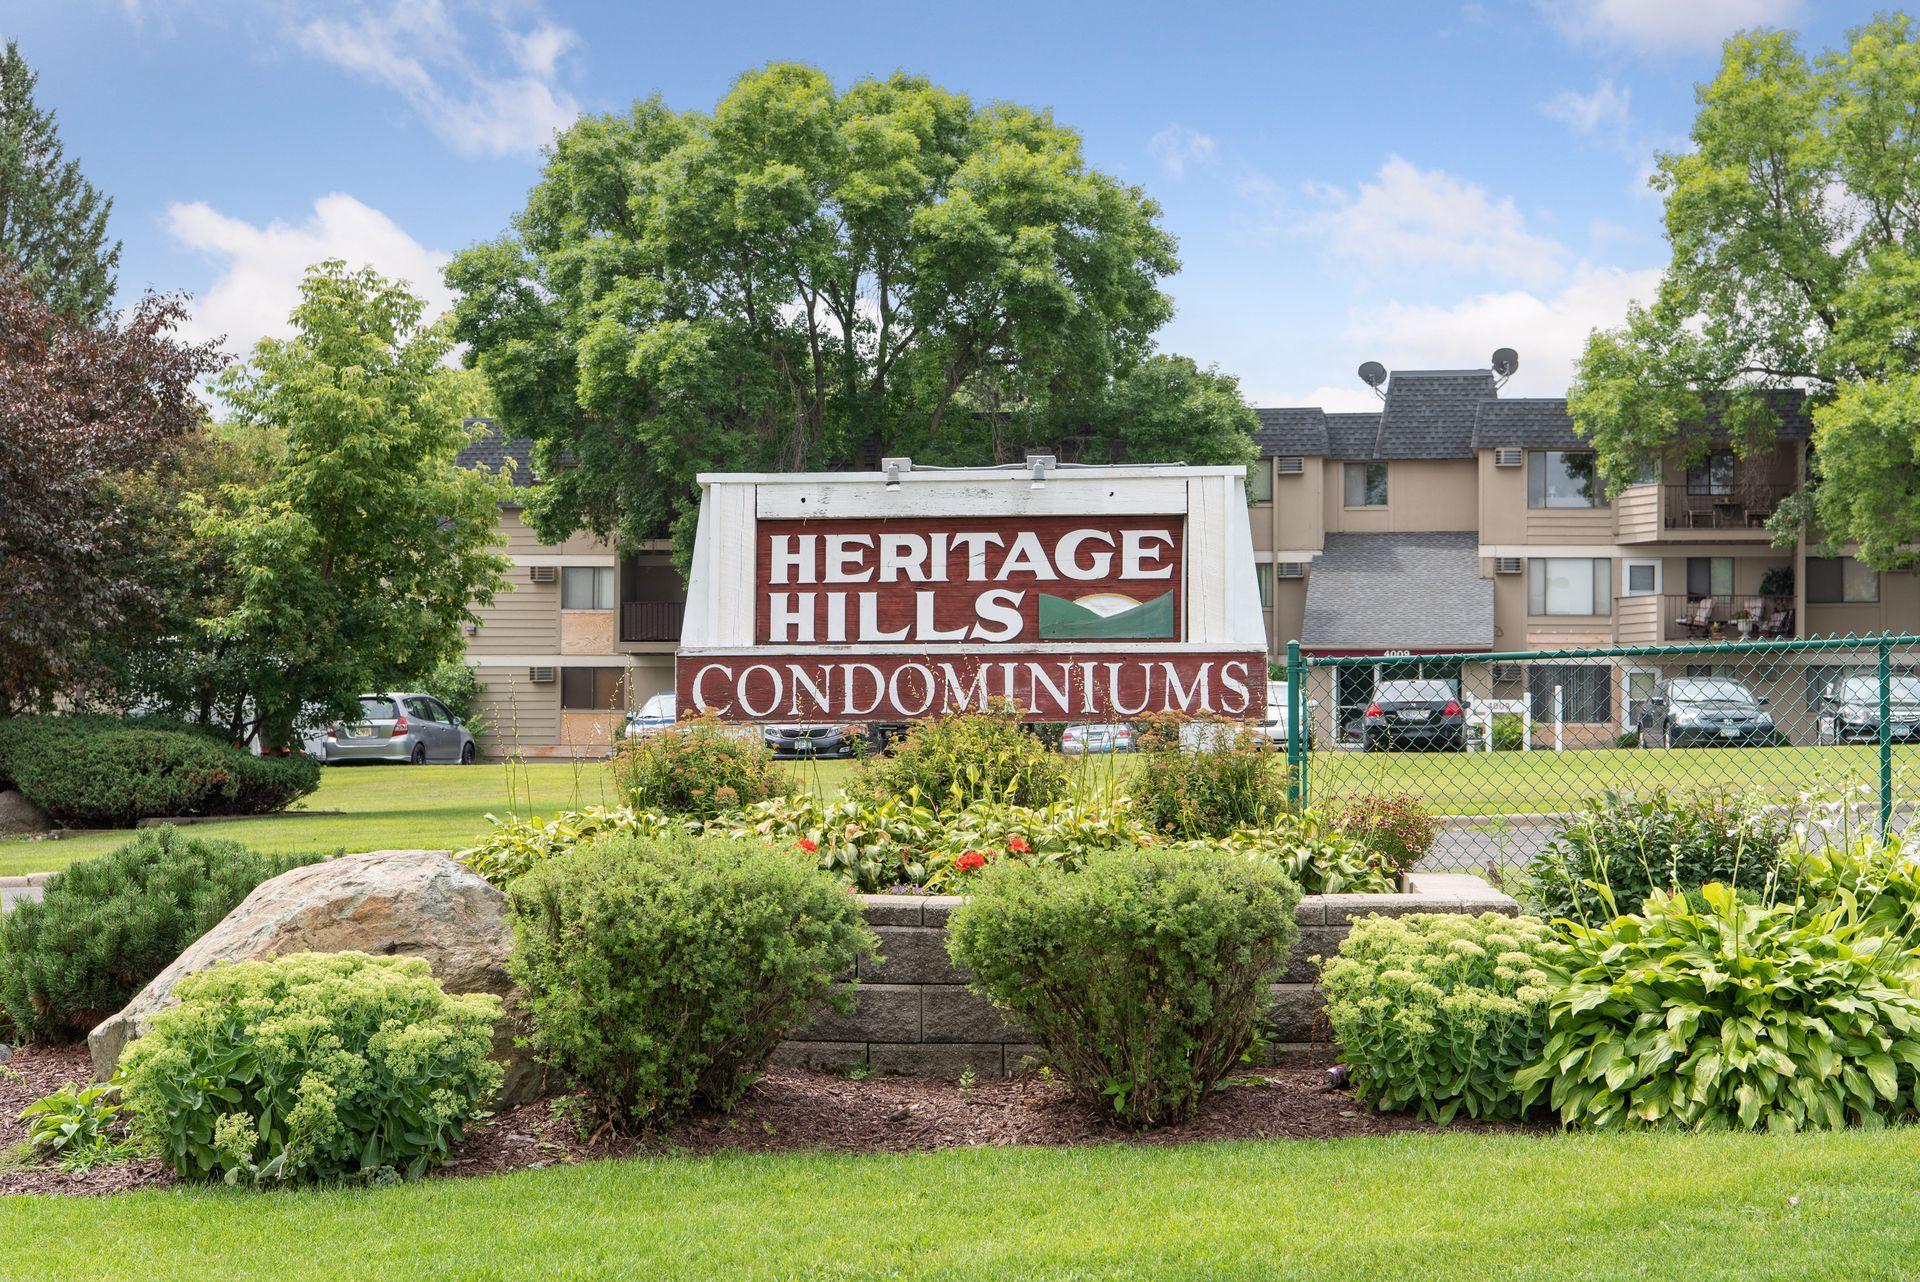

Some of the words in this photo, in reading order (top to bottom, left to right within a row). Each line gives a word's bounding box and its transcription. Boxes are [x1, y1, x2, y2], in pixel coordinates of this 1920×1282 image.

[769, 529, 1175, 584] HERITAGE
[769, 589, 1026, 642] HILLS
[692, 661, 1250, 717] CONDOMINIUMS
